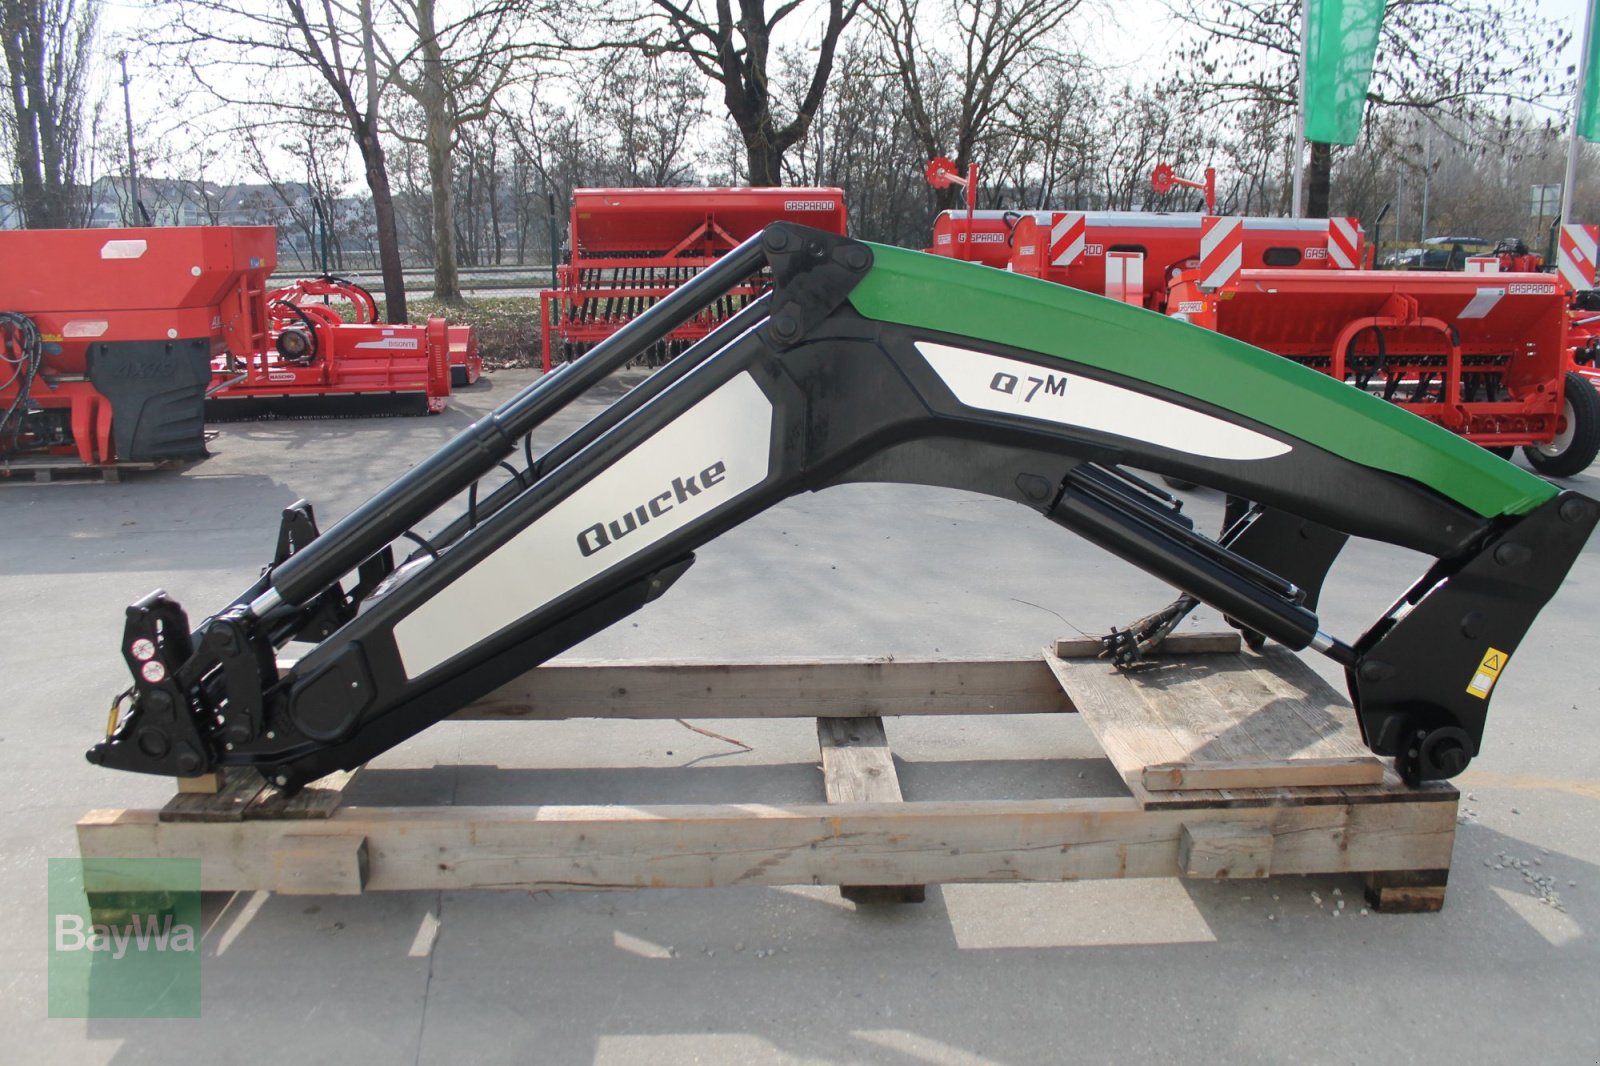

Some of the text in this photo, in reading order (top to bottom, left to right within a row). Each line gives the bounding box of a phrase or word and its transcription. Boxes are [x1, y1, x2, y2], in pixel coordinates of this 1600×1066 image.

[785, 201, 834, 211] GASPARDO
[959, 233, 1004, 243] GSPARDO
[1508, 283, 1555, 294] GASPARDO
[990, 372, 1018, 394] Q
[576, 461, 726, 557] Quicke
